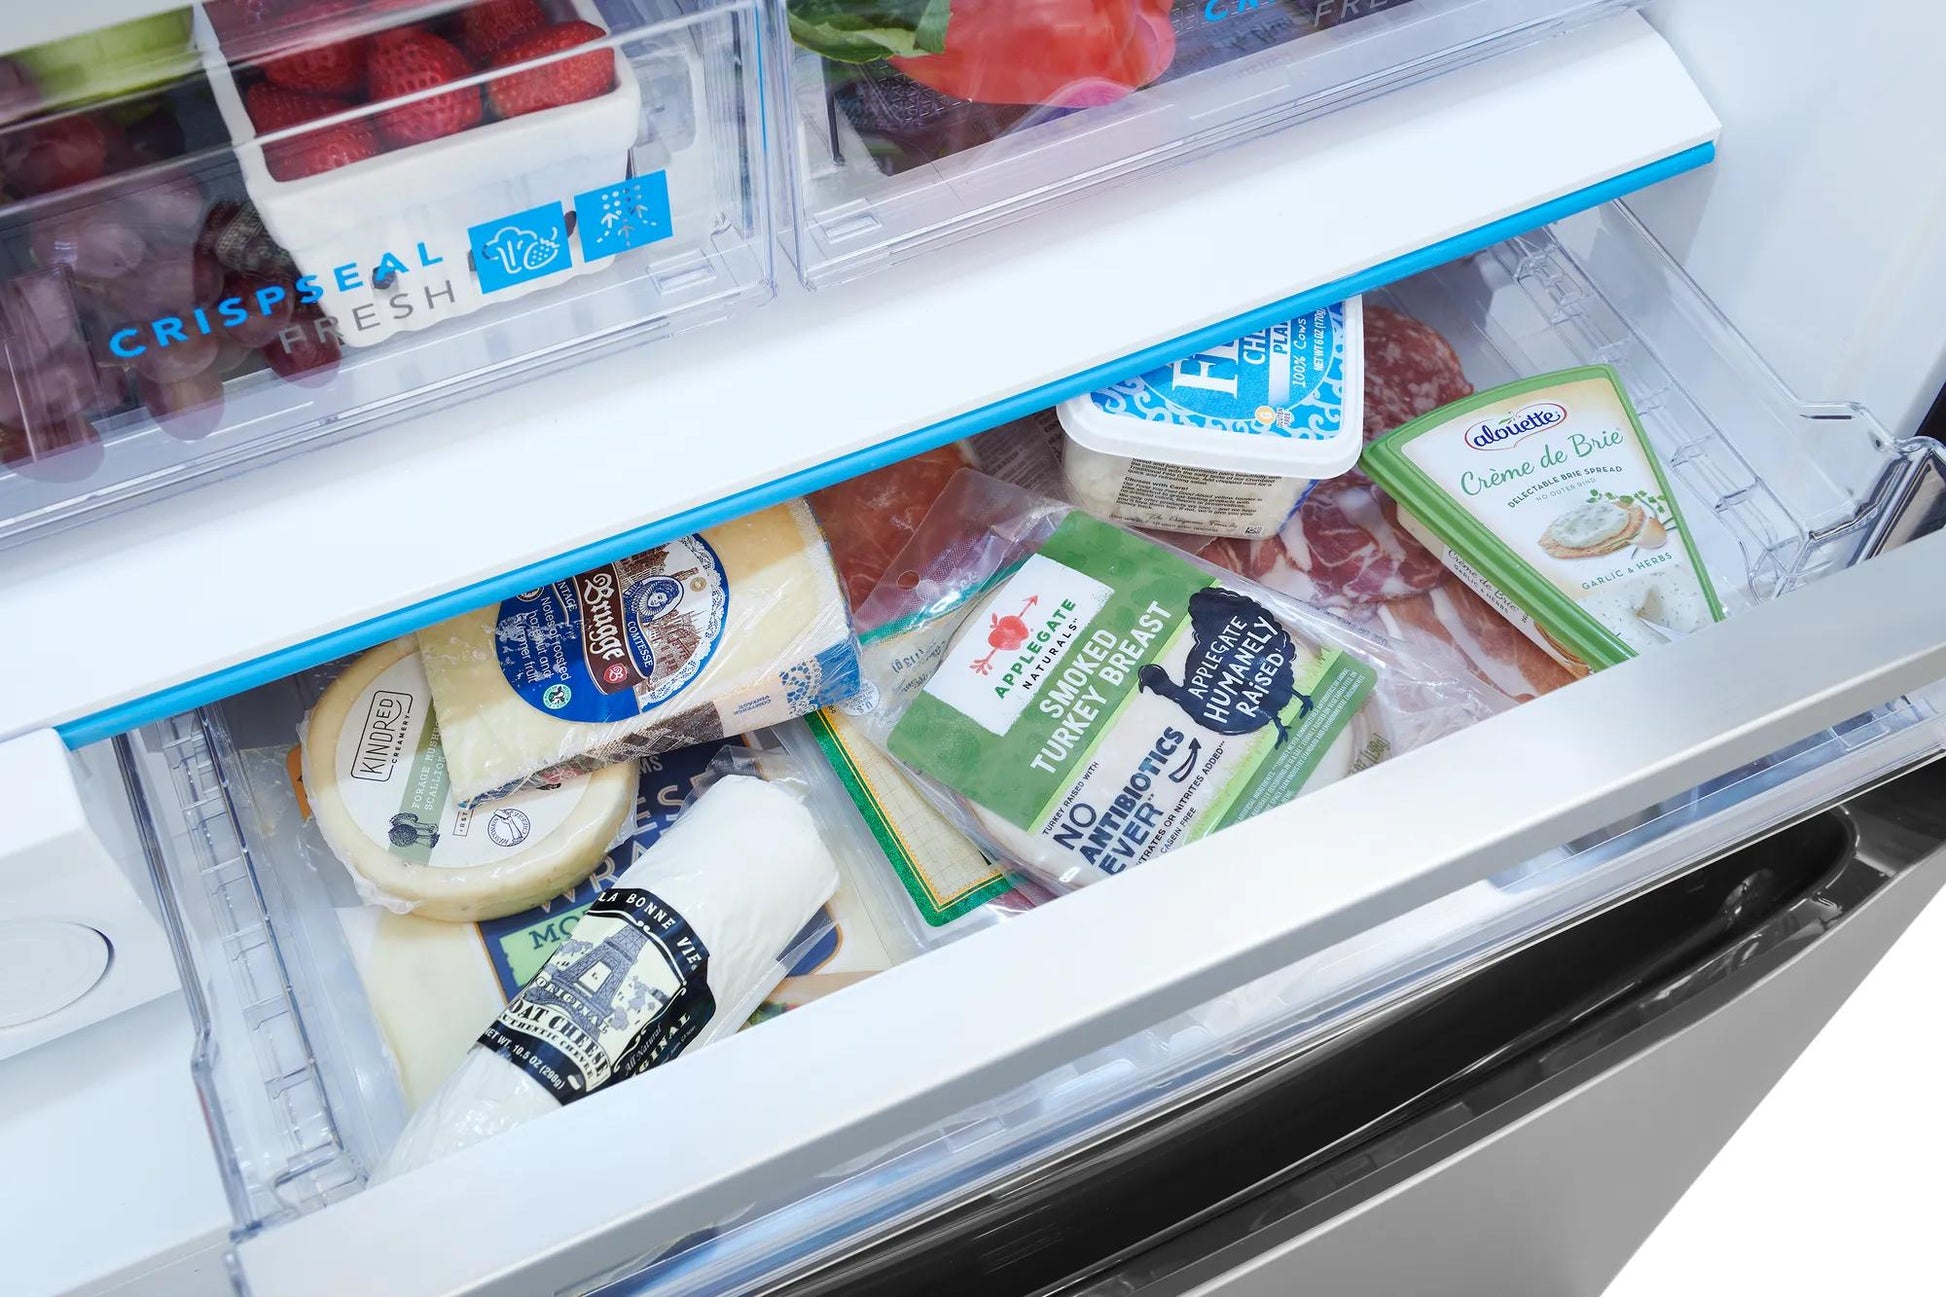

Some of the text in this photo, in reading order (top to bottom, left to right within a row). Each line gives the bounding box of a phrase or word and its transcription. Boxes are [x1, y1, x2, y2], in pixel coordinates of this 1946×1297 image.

[109, 241, 443, 358] CRISPSEAL
[278, 280, 456, 354] FRESH
[1292, 355, 1306, 388] 100%
[1473, 409, 1561, 448] alouette
[1460, 429, 1624, 496] Crème de Brie
[1507, 465, 1623, 509] DELECTABLE BRIE SPREAD
[1535, 477, 1597, 503] NO OUTER RIND
[557, 581, 578, 612] NTAGE
[1454, 564, 1479, 588] GARLIC
[1486, 593, 1509, 613] HERBS
[1581, 552, 1673, 591] GARLIC & HERBS
[541, 596, 556, 627] Notes
[549, 627, 558, 640] of
[583, 573, 625, 662] Brugge
[626, 620, 653, 668] COMTESSE
[539, 656, 555, 679] and
[994, 598, 1076, 700] APPLEGATE
[1039, 629, 1117, 718] SMOKED
[1187, 615, 1248, 700] APPLEGATE
[1203, 615, 1278, 723] HUMANELY
[1030, 686, 1108, 774] TURKEY
[1099, 600, 1172, 686] BREAST
[359, 698, 402, 775] KINDRED
[391, 713, 411, 764] CREAMERY
[411, 766, 430, 809] FORAGE
[424, 755, 445, 811] SCALLION
[1042, 761, 1100, 836] TURKEY RAISED WITH
[1079, 726, 1185, 866] ANTIBIOTICS
[1053, 802, 1097, 851] NO
[1137, 828, 1166, 865] TRATES
[1163, 814, 1176, 828] OR
[1174, 775, 1204, 813] NITRITES
[1160, 806, 1197, 854] CASEIN FREE
[597, 891, 702, 965] LA BONNE VIE
[536, 977, 609, 1034] ORIGINAL
[497, 1036, 512, 1049] WT.
[512, 1044, 531, 1060] 10.5
[528, 1055, 543, 1068] OZ
[501, 1013, 593, 1078] UTHENTIC CHEVRE
[508, 998, 609, 1077] OAT CHEESE
[633, 1013, 691, 1076] GINAL
[636, 1022, 661, 1061] Natural
